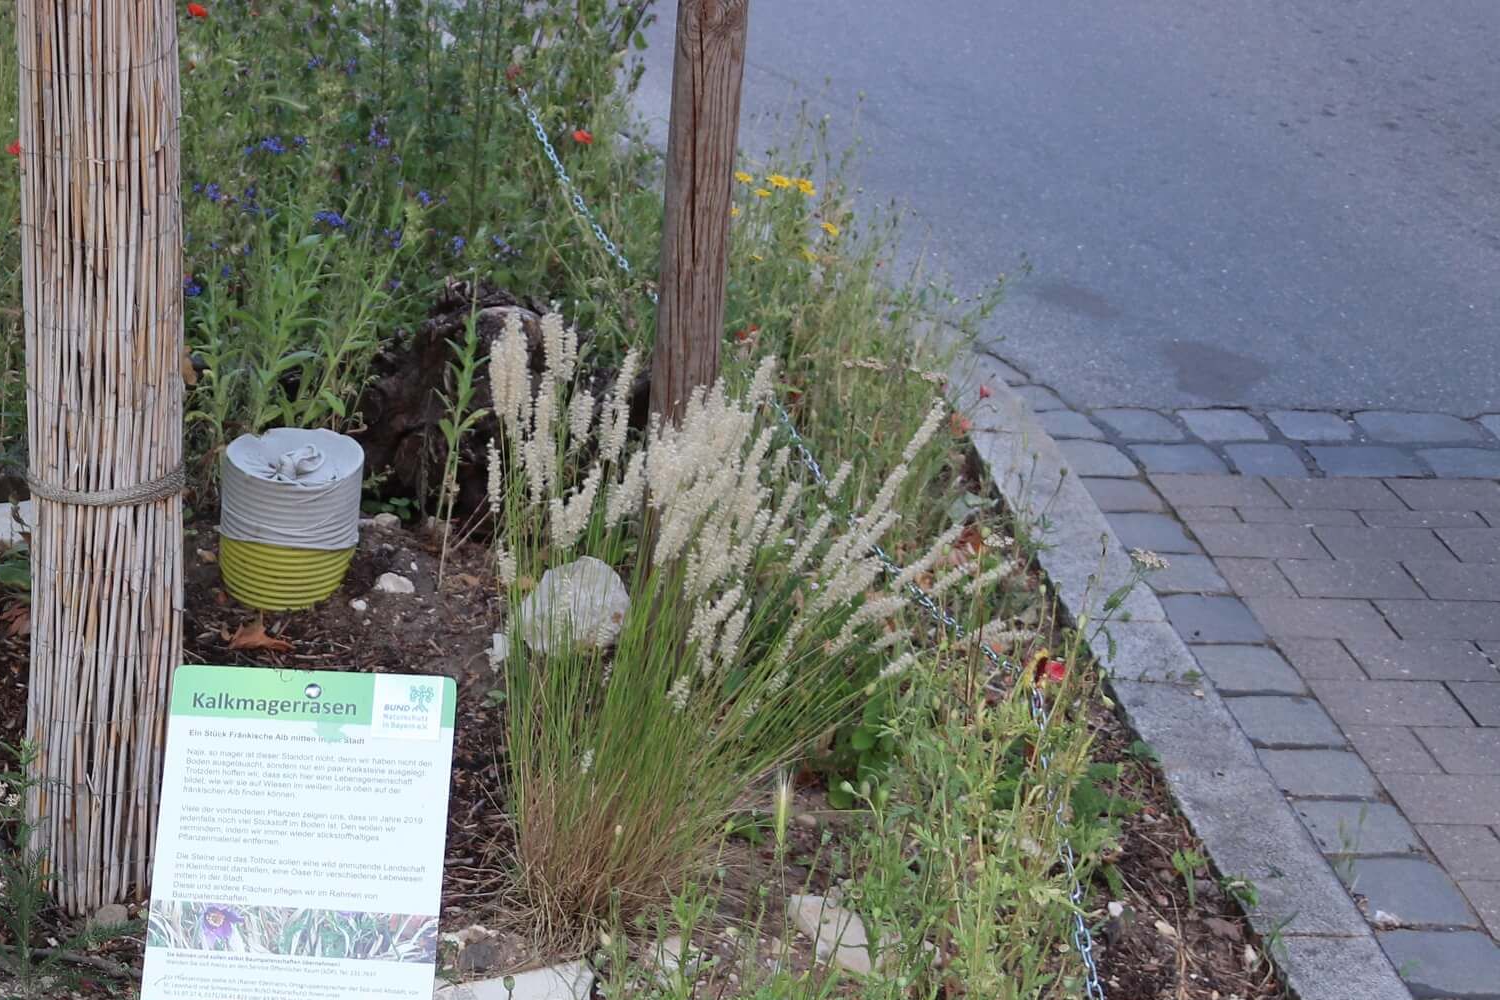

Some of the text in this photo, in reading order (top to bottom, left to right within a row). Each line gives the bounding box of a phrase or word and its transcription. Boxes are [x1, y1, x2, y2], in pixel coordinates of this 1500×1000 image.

[192, 692, 357, 716] Kalkmagerrasen
[383, 704, 411, 712] BUND
[382, 714, 428, 722] Naturschutz
[229, 731, 273, 740] Fränkische
[282, 753, 314, 761] Standort
[372, 758, 396, 766] haben
[185, 767, 220, 775] Trotzdem
[267, 809, 300, 818] Pflanzen
[253, 818, 287, 826] Stickstoff
[191, 853, 215, 861] Steine
[383, 864, 425, 873] Landschaft
[173, 881, 195, 889] Diese
[242, 885, 273, 894] Flächen
